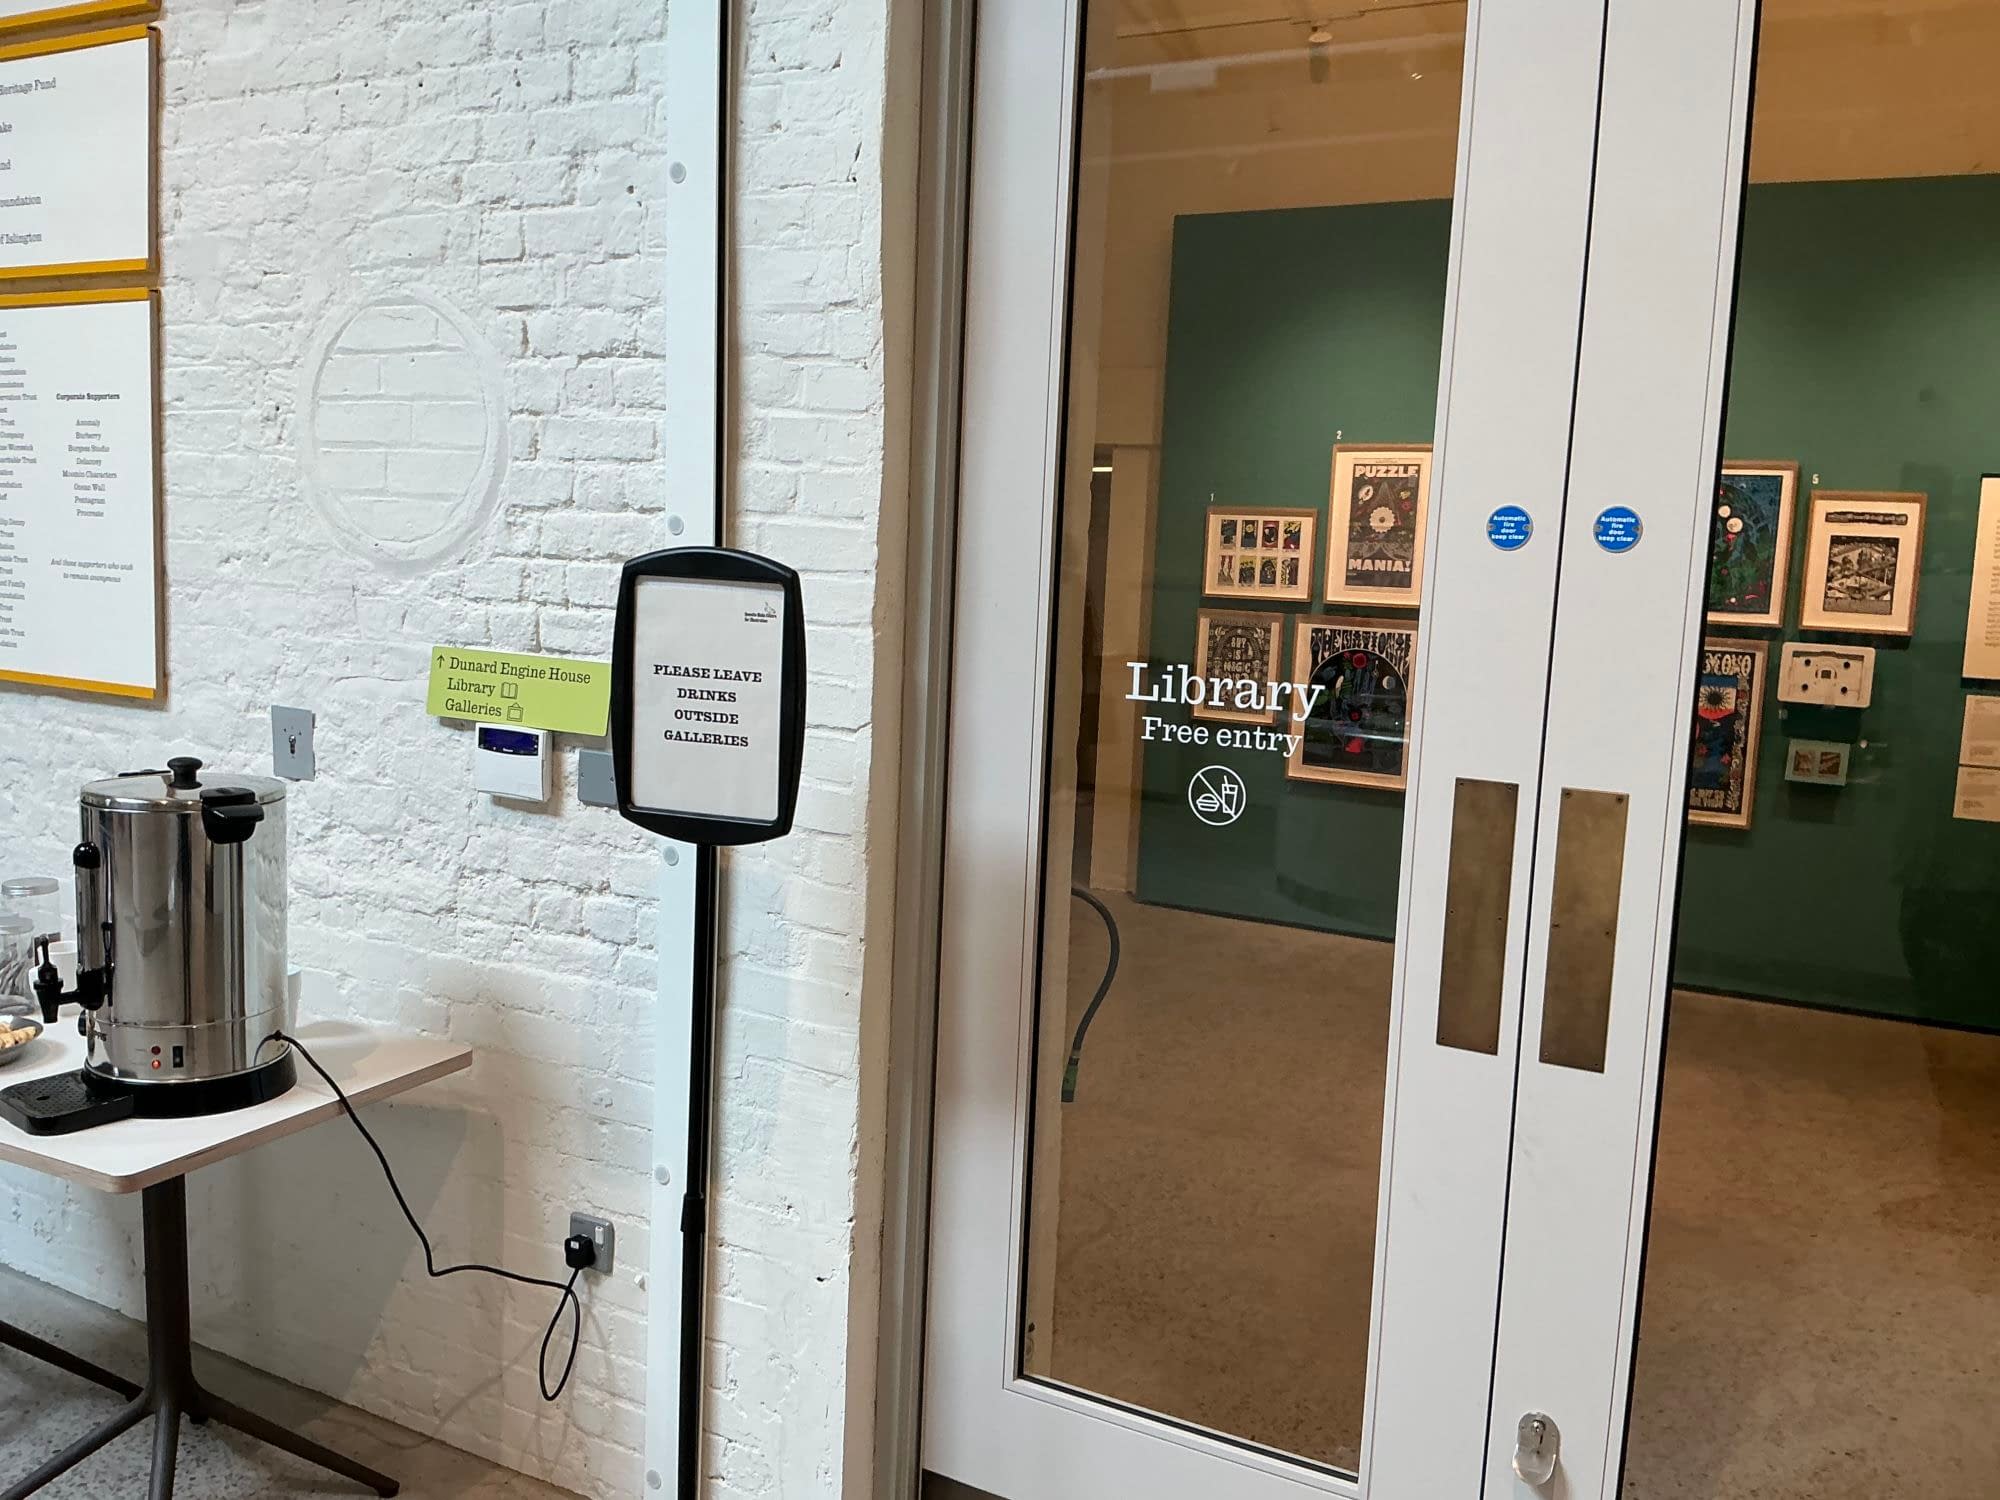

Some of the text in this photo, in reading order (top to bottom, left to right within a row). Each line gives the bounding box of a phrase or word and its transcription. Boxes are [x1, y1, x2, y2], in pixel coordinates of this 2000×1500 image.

[34, 77, 57, 90] Fund
[5, 233, 42, 245] Islington
[56, 393, 120, 401] Corporate Supporters
[1336, 430, 1342, 440] 2
[1354, 465, 1418, 478] PUZZLE
[1812, 473, 1819, 485] 5
[1491, 533, 1507, 541] keep
[1348, 558, 1411, 573] MANIA!
[449, 657, 591, 684] Dunard Engine House
[653, 664, 762, 683] PLEASE LEAVE
[447, 677, 496, 697] Library
[676, 687, 737, 702] DRINKS
[1125, 661, 1326, 721] Library
[445, 698, 502, 717] Galleries
[674, 709, 739, 725] OUTSIDE
[663, 729, 749, 747] GALLERIES
[1141, 716, 1303, 758] Free entry
